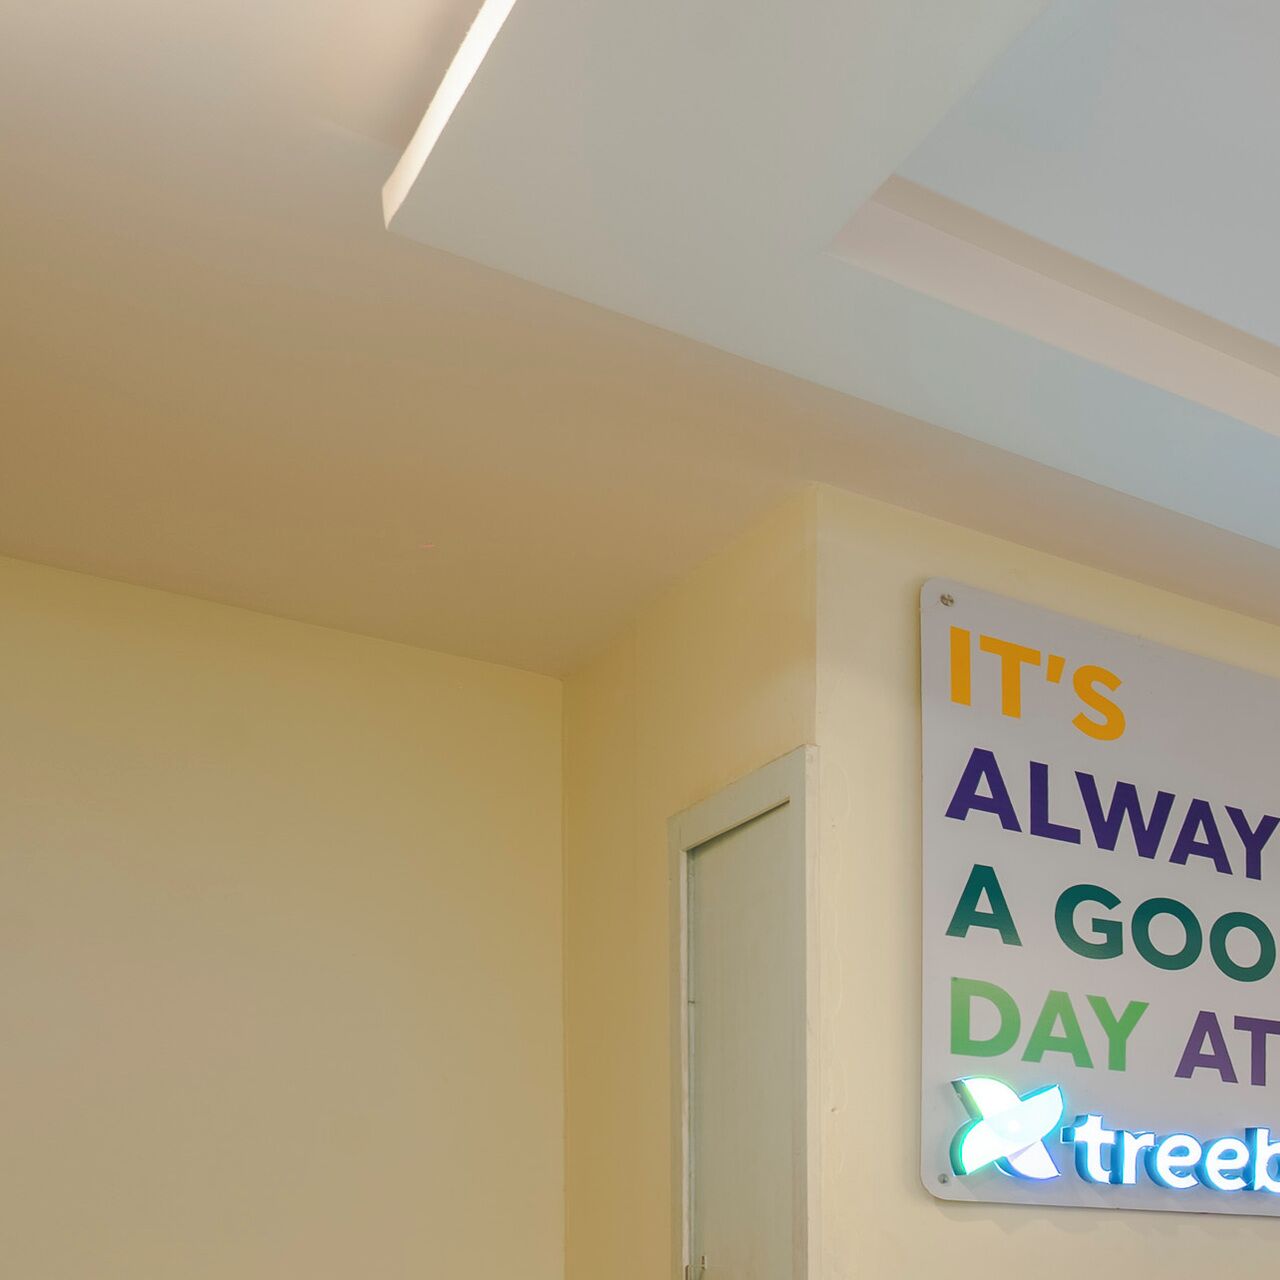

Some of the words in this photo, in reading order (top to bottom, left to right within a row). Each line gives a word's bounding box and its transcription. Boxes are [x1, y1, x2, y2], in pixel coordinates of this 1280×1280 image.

[950, 626, 1126, 741] IT'S
[945, 864, 1022, 947] A
[950, 977, 1149, 1072] DAY
